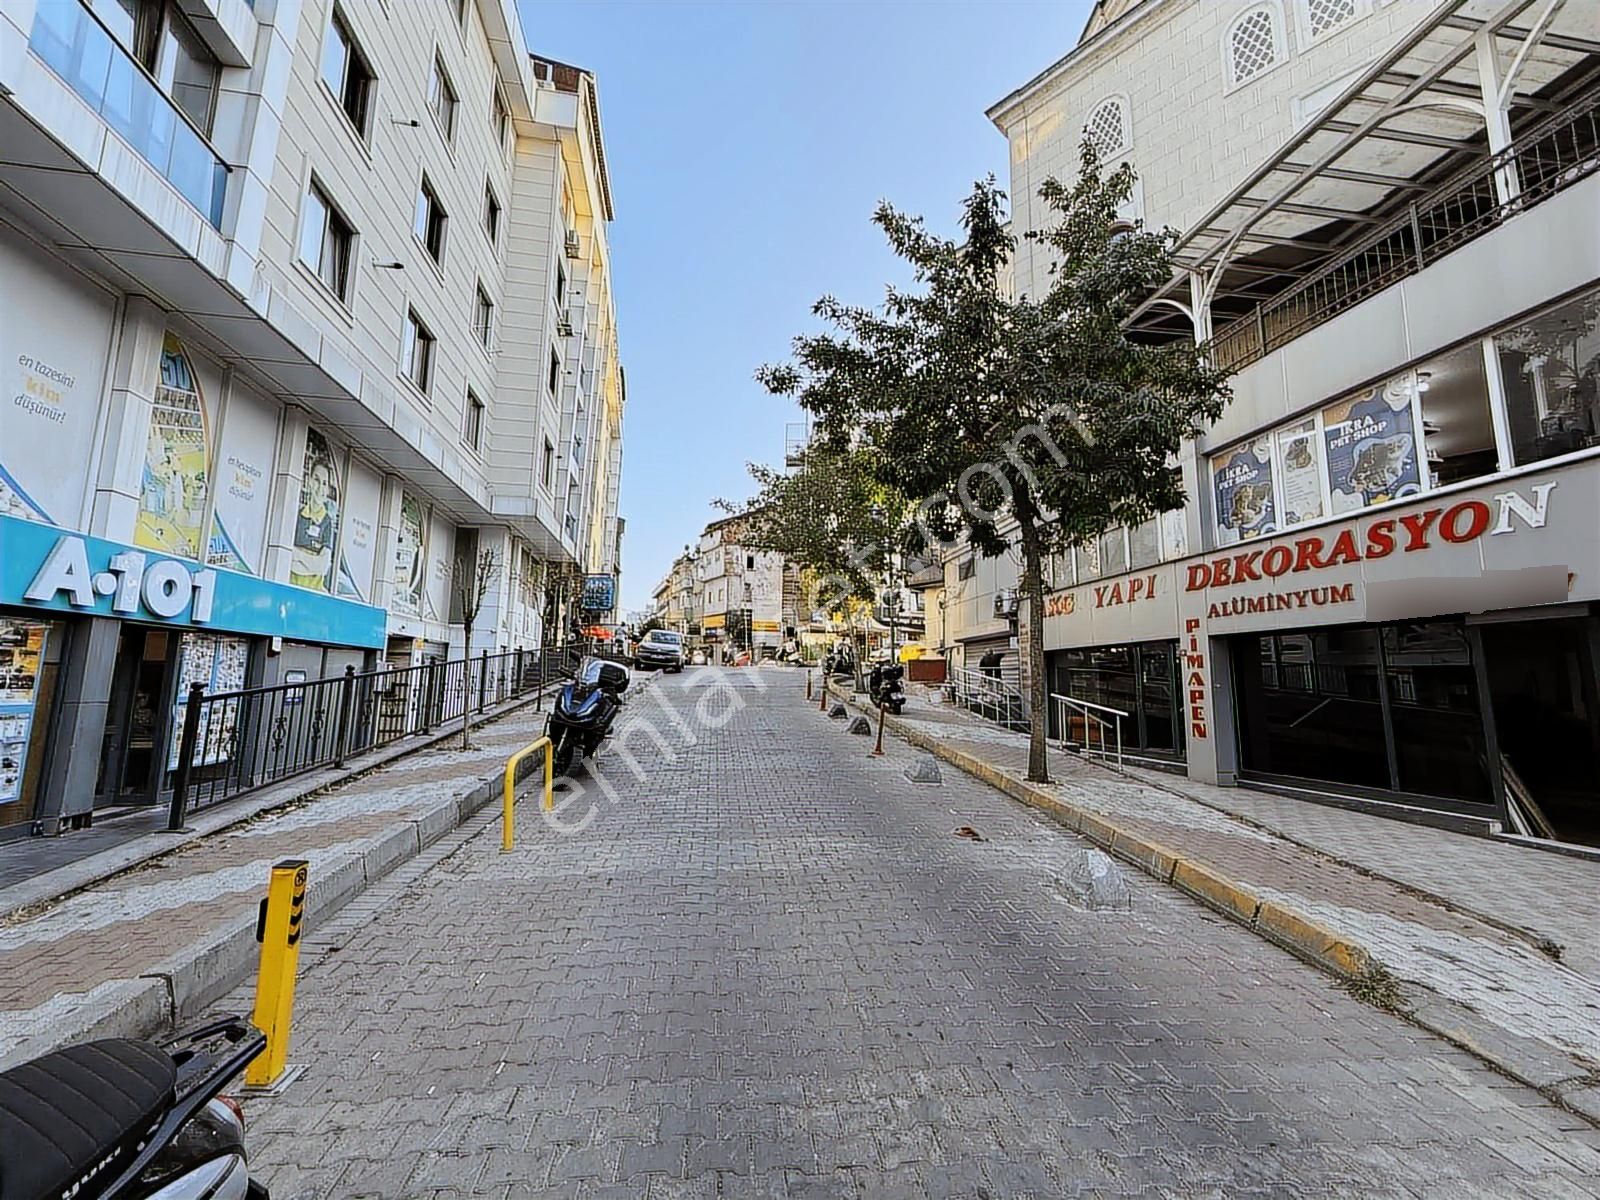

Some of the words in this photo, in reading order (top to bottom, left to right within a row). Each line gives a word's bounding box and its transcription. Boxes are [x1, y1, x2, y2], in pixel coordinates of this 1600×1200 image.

[18, 354, 34, 368] en
[34, 361, 76, 388] tazesini
[14, 393, 67, 424] düşünür!
[1353, 420, 1387, 441] SHOP
[1094, 574, 1157, 609] YAPI
[1186, 480, 1558, 593] DEKORASYON
[1207, 583, 1355, 620] ALÜMİNYUM
